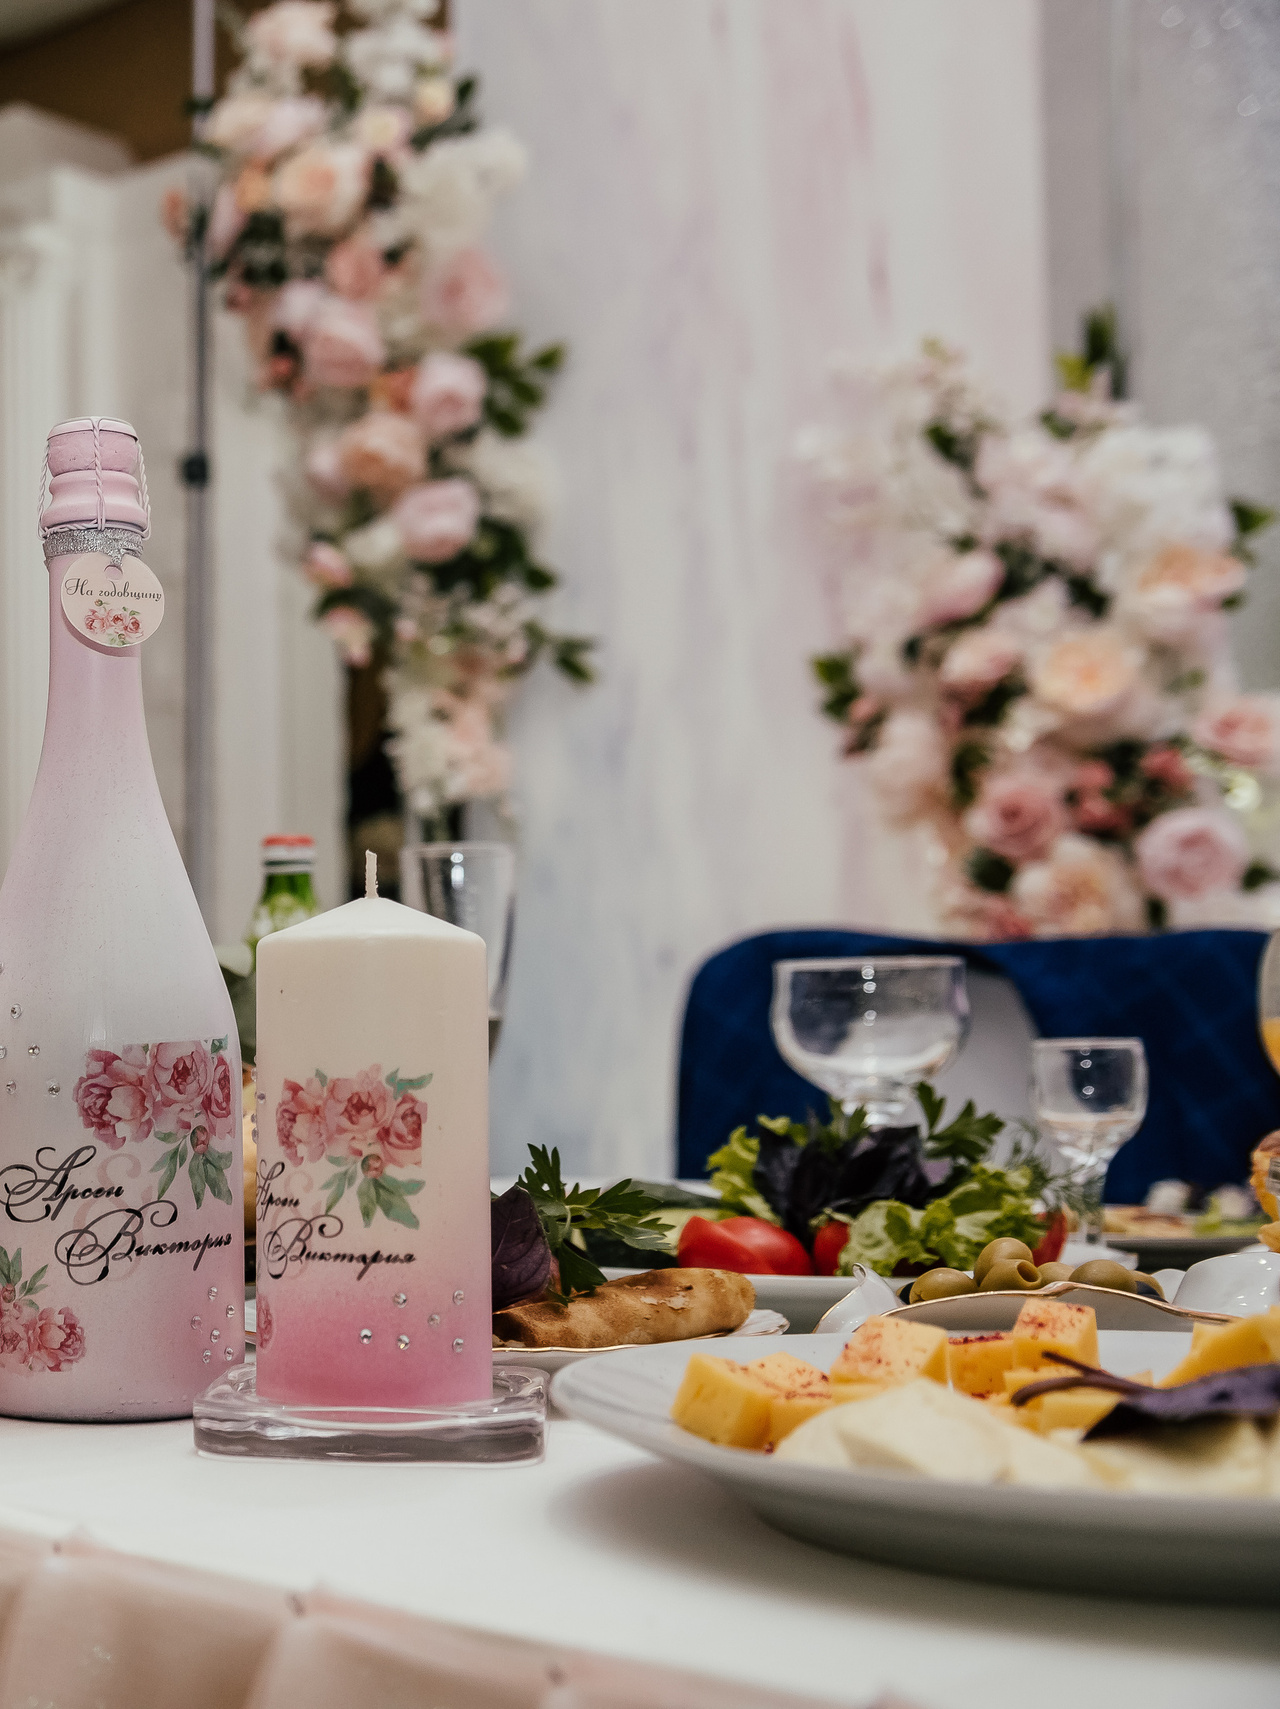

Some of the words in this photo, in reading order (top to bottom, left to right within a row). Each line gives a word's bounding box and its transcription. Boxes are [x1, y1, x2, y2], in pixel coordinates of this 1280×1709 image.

[64, 578, 93, 596] На
[99, 580, 162, 601] годовщину
[54, 1199, 232, 1285] Виктория
[262, 1214, 416, 1281] Виктория
